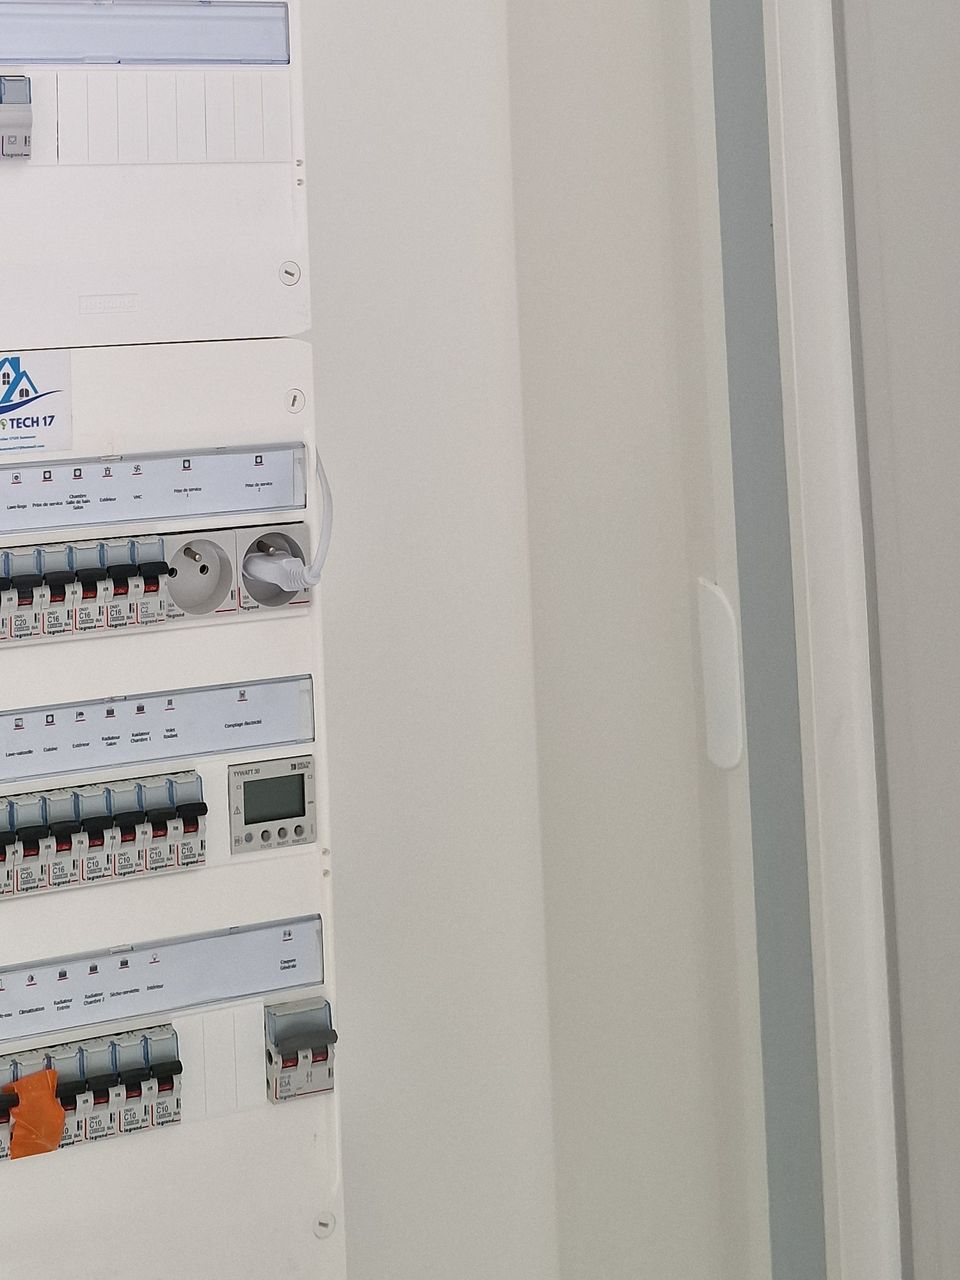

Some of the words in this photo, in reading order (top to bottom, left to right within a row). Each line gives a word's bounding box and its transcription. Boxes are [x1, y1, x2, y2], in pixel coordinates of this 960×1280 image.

[9, 416, 39, 430] TECH
[42, 415, 55, 427] 17
[78, 611, 91, 620] C16
[110, 609, 122, 617] C16
[14, 619, 27, 627] C20
[47, 615, 60, 624] C16
[181, 846, 194, 855] C10
[149, 851, 162, 859] C10
[86, 861, 100, 869] C10
[118, 857, 130, 865] C10
[52, 866, 65, 874] C16
[20, 871, 33, 880] C20
[156, 1105, 169, 1113] C10
[124, 1113, 137, 1121] C10
[89, 1121, 102, 1129] C10
